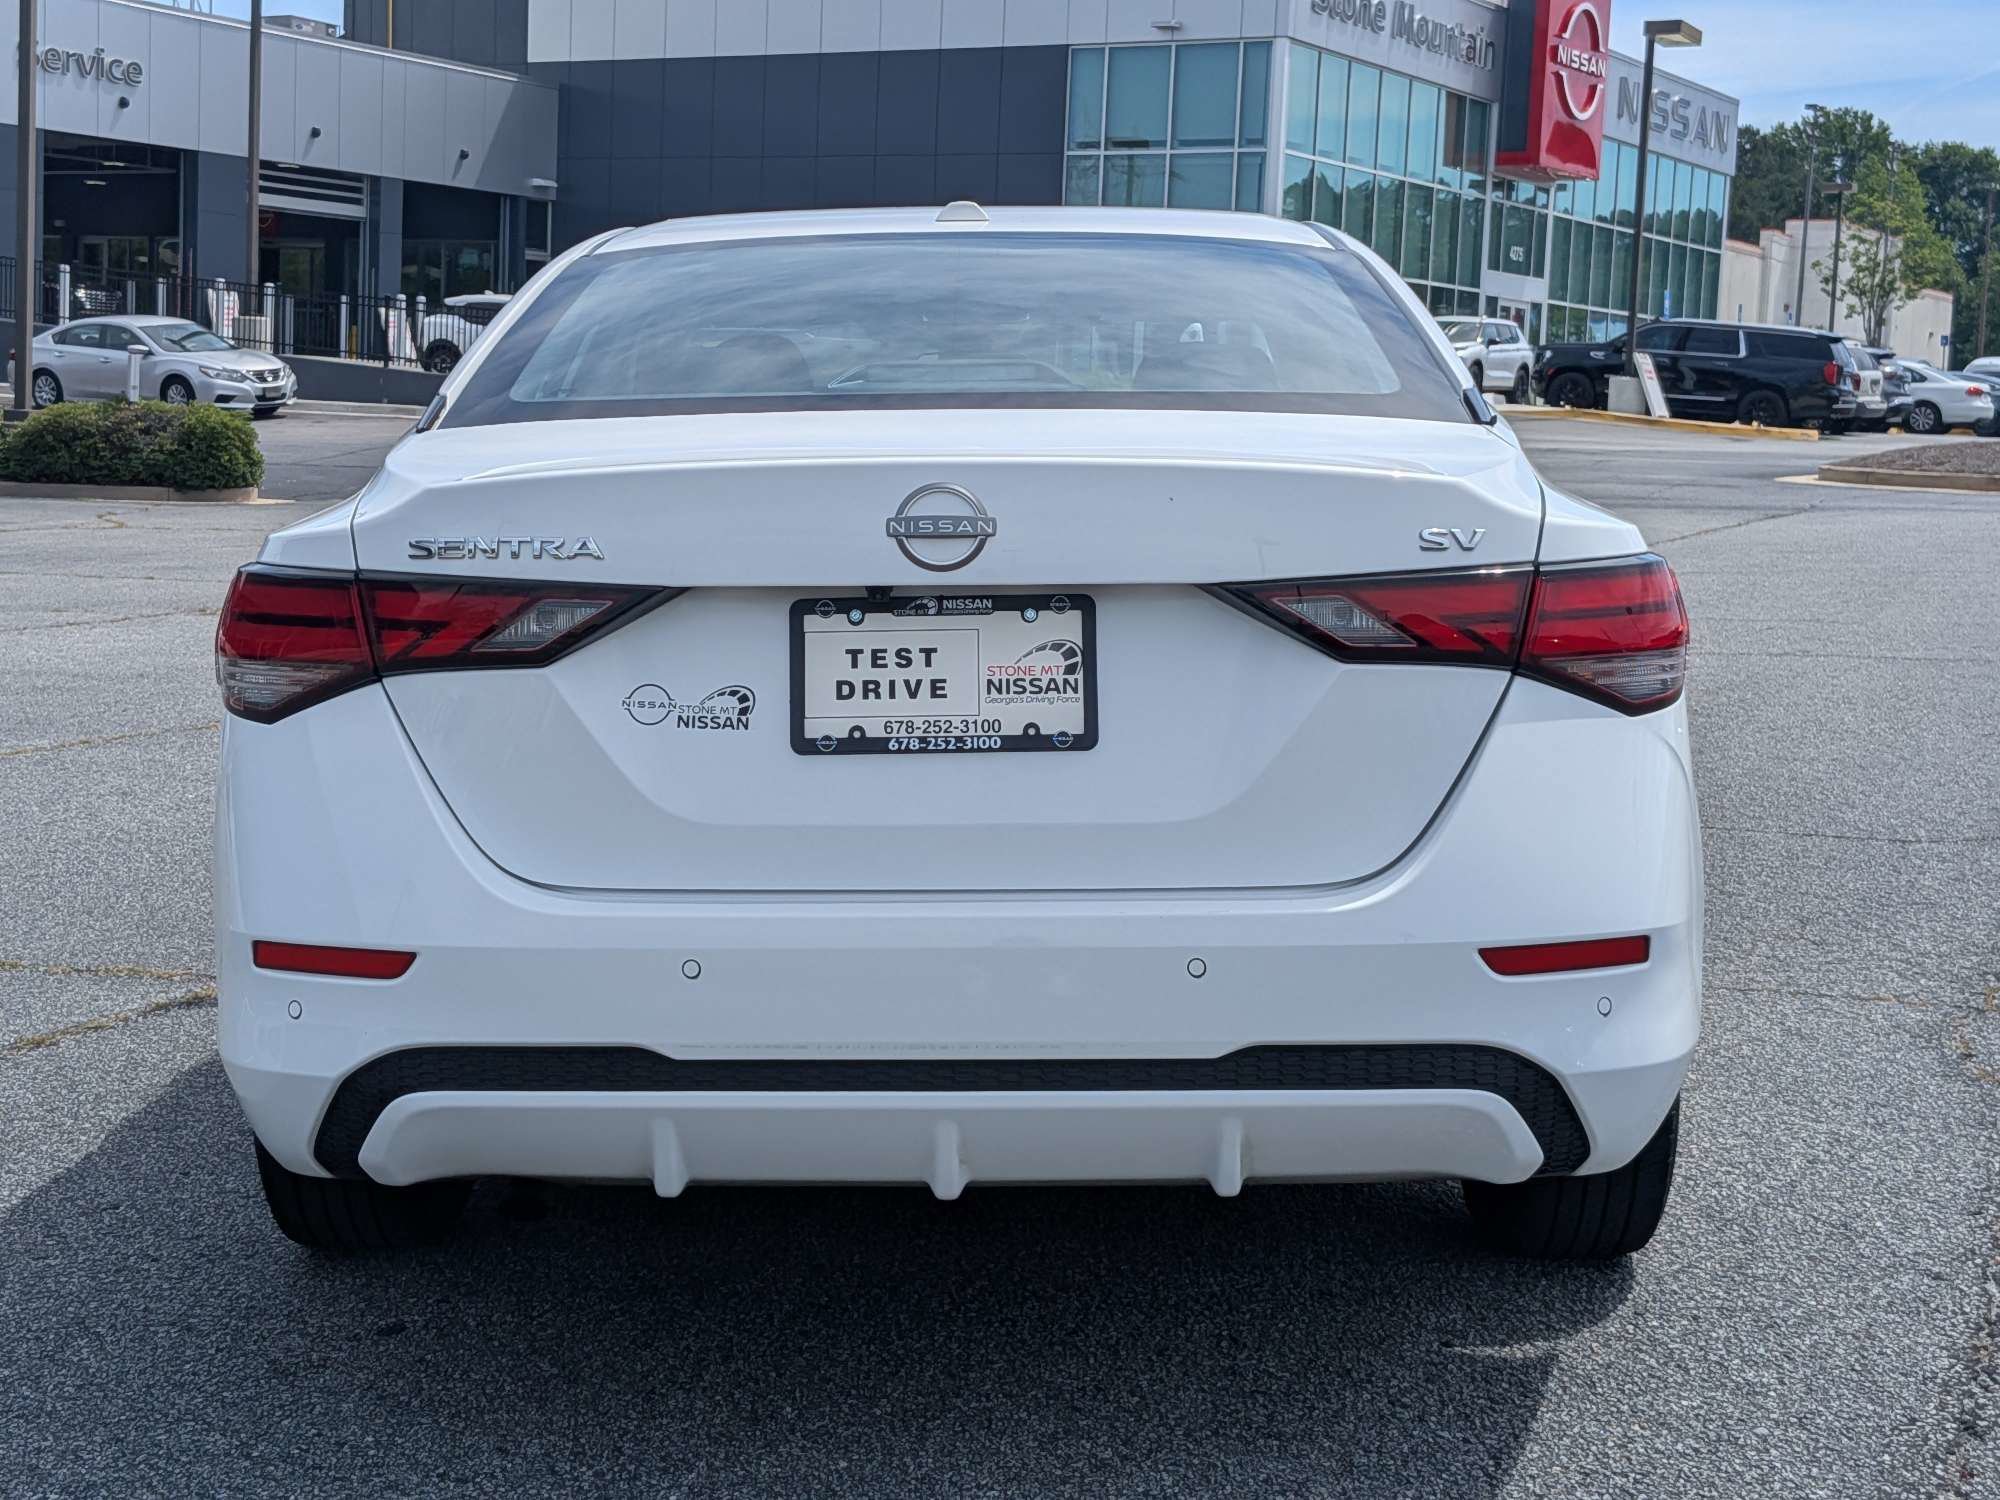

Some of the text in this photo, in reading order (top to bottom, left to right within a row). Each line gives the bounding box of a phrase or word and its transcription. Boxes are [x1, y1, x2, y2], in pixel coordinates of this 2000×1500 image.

[1391, 1, 1496, 71] Mountain
[34, 40, 144, 87] ervice
[1557, 44, 1607, 79] NISSAN
[1617, 76, 1730, 153] NSSAN
[889, 520, 993, 533] NISSAN
[408, 536, 604, 560] SENTRA
[1419, 528, 1486, 551] SV
[943, 599, 992, 609] NISSAN
[845, 647, 938, 669] TEST
[987, 665, 1063, 676] STONE MT
[836, 678, 948, 701] DRIVE
[987, 677, 1079, 695] NISSAN
[621, 699, 678, 710] NISSAN
[984, 695, 1080, 706] Georgia's Driving Force
[678, 704, 738, 716] STONE MT
[676, 714, 750, 731] NISSAN
[883, 718, 1002, 735] 678-252-3100
[888, 736, 1001, 751] 678-252-3100
